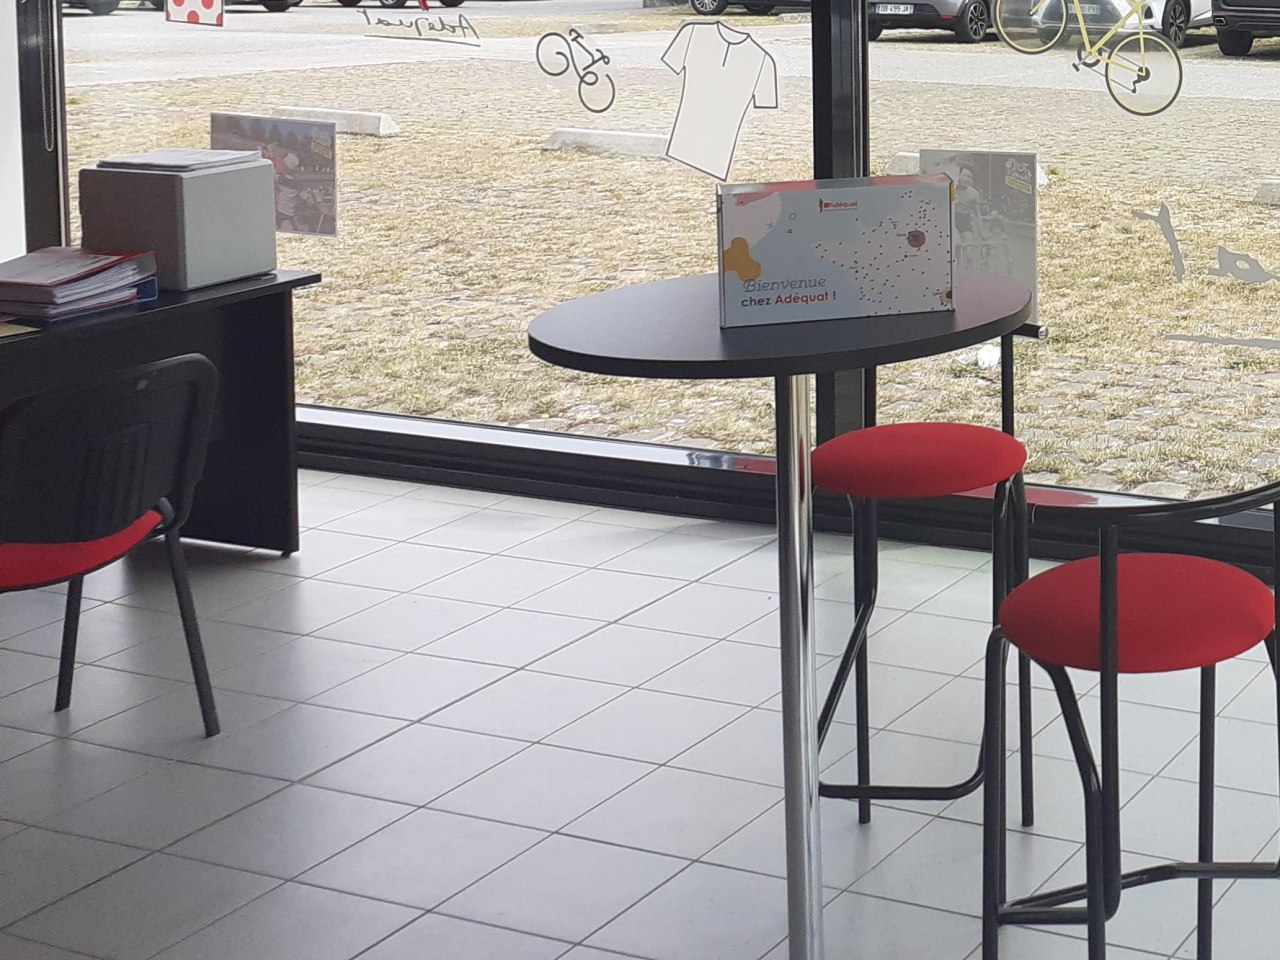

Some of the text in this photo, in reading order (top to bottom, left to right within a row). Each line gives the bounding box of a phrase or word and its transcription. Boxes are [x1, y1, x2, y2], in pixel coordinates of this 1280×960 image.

[743, 278, 826, 293] Bienvenue
[741, 296, 772, 307] chez
[775, 291, 829, 305] Adéquat
